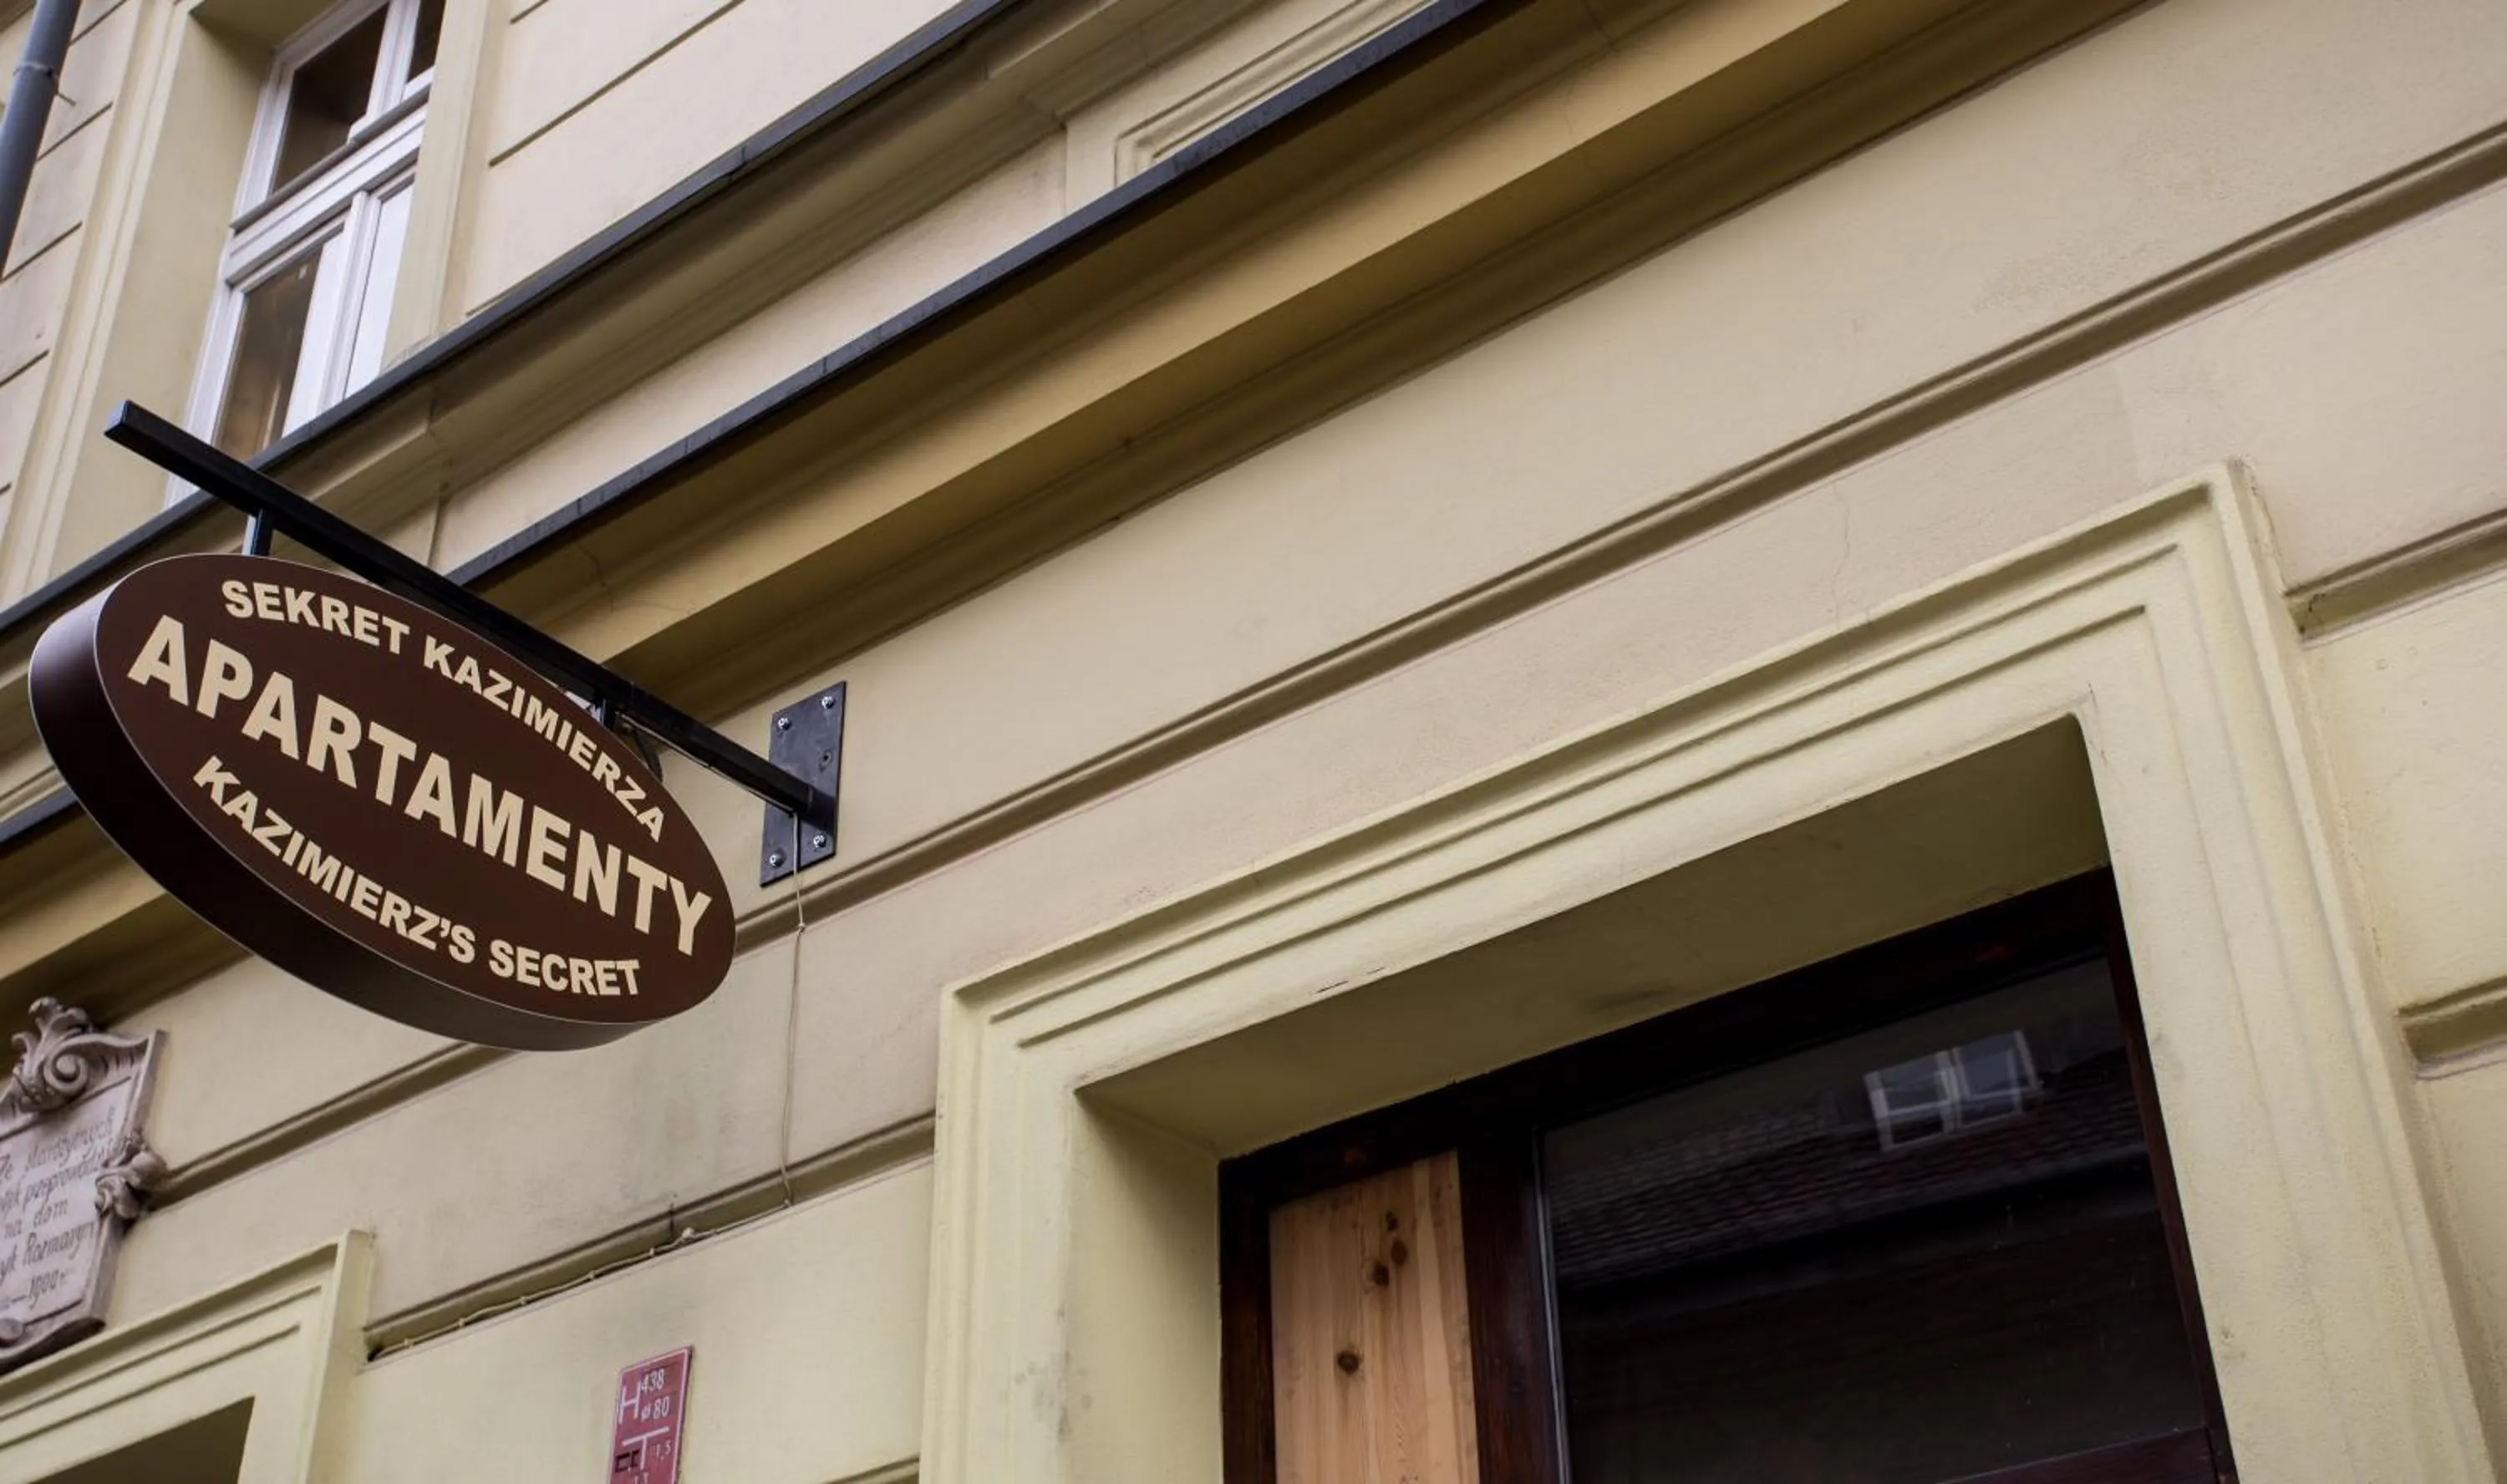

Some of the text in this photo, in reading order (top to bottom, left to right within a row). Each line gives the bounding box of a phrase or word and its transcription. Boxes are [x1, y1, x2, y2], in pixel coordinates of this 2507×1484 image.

[127, 614, 713, 957] APARTAMENTY
[221, 580, 665, 843] SEKRET KAZIMIERZA
[193, 755, 640, 996] KAZIMIERZ'S SECRET
[618, 1380, 641, 1425] H
